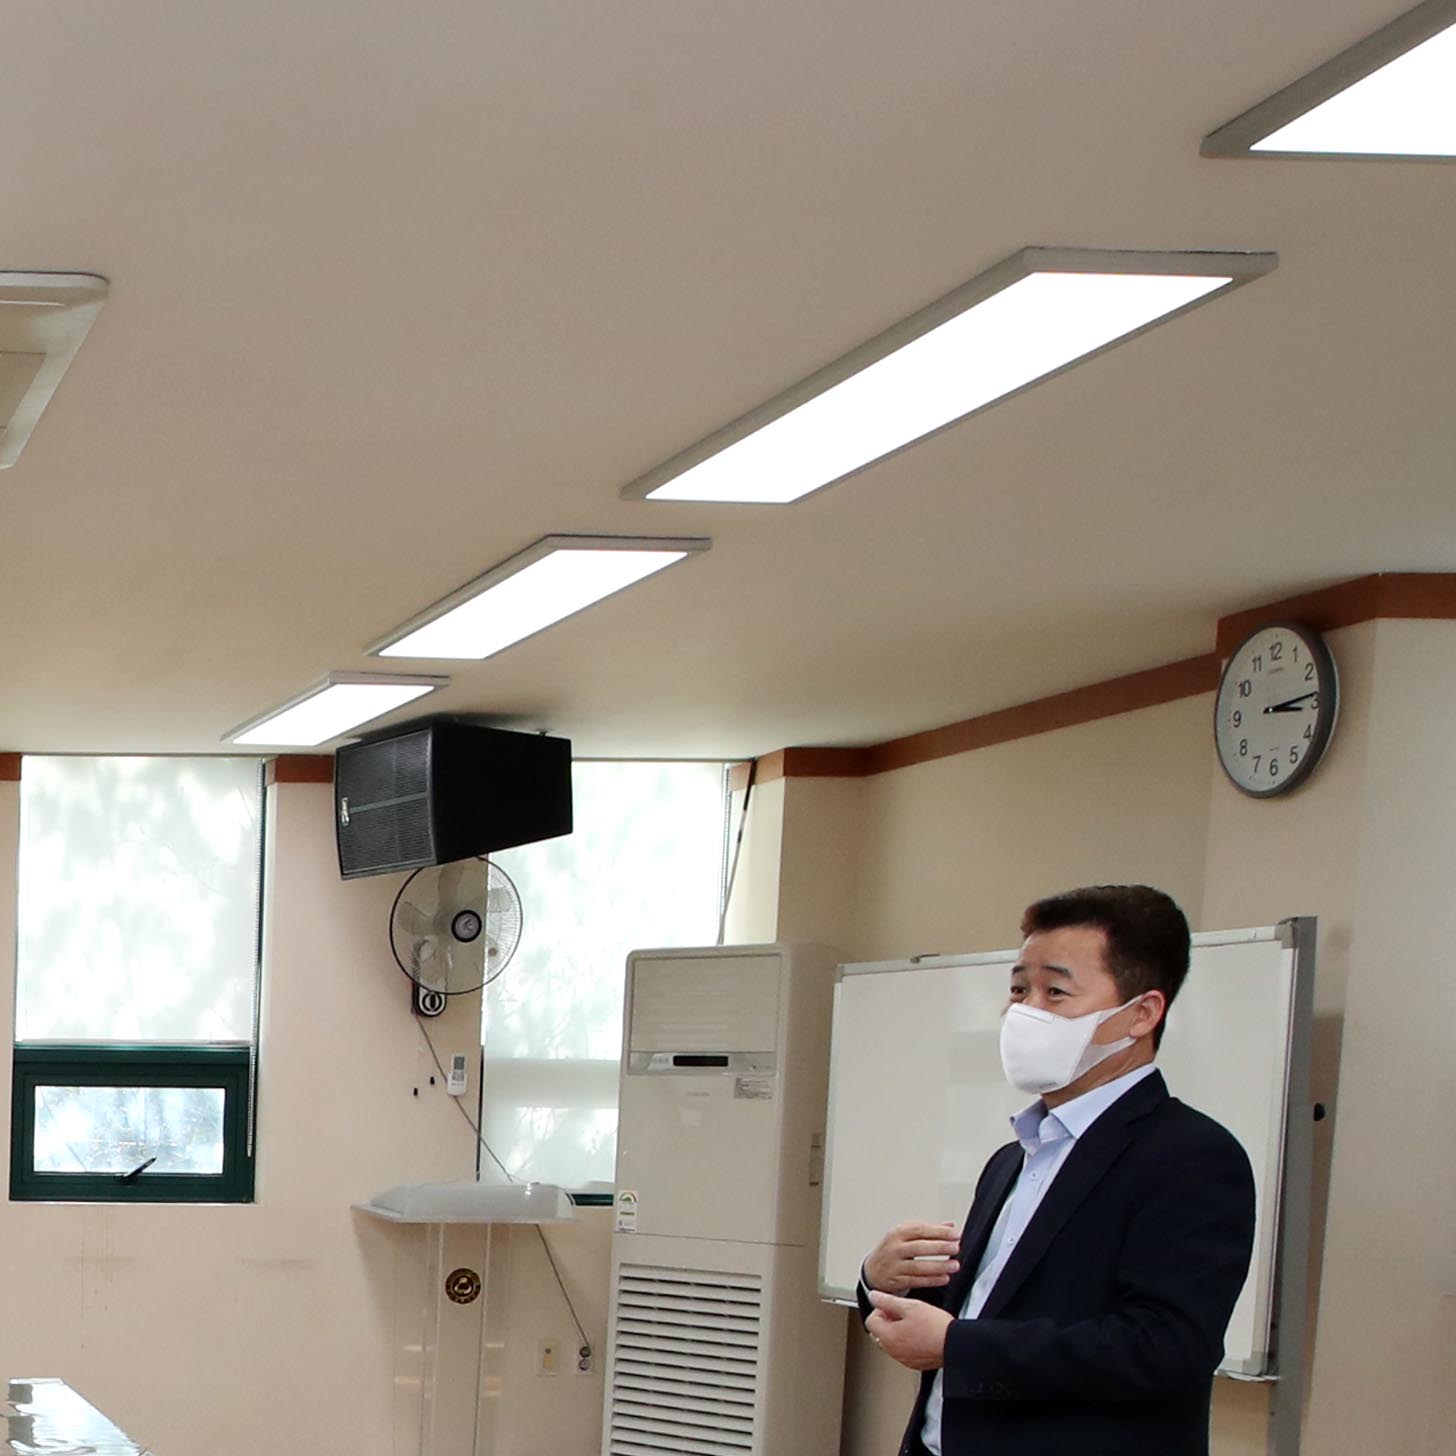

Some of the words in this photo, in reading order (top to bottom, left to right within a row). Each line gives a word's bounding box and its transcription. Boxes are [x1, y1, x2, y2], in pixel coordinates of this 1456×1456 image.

[1269, 641, 1283, 661] 12
[1292, 646, 1298, 663] 1
[1252, 655, 1262, 673] 11
[1304, 662, 1314, 681] 2
[1238, 679, 1252, 698] 10
[1232, 710, 1242, 728] 9
[1303, 723, 1312, 740] 4
[1239, 738, 1248, 756] 8
[1289, 746, 1299, 765] 5
[1252, 755, 1262, 774] 7
[1269, 758, 1279, 777] 6
